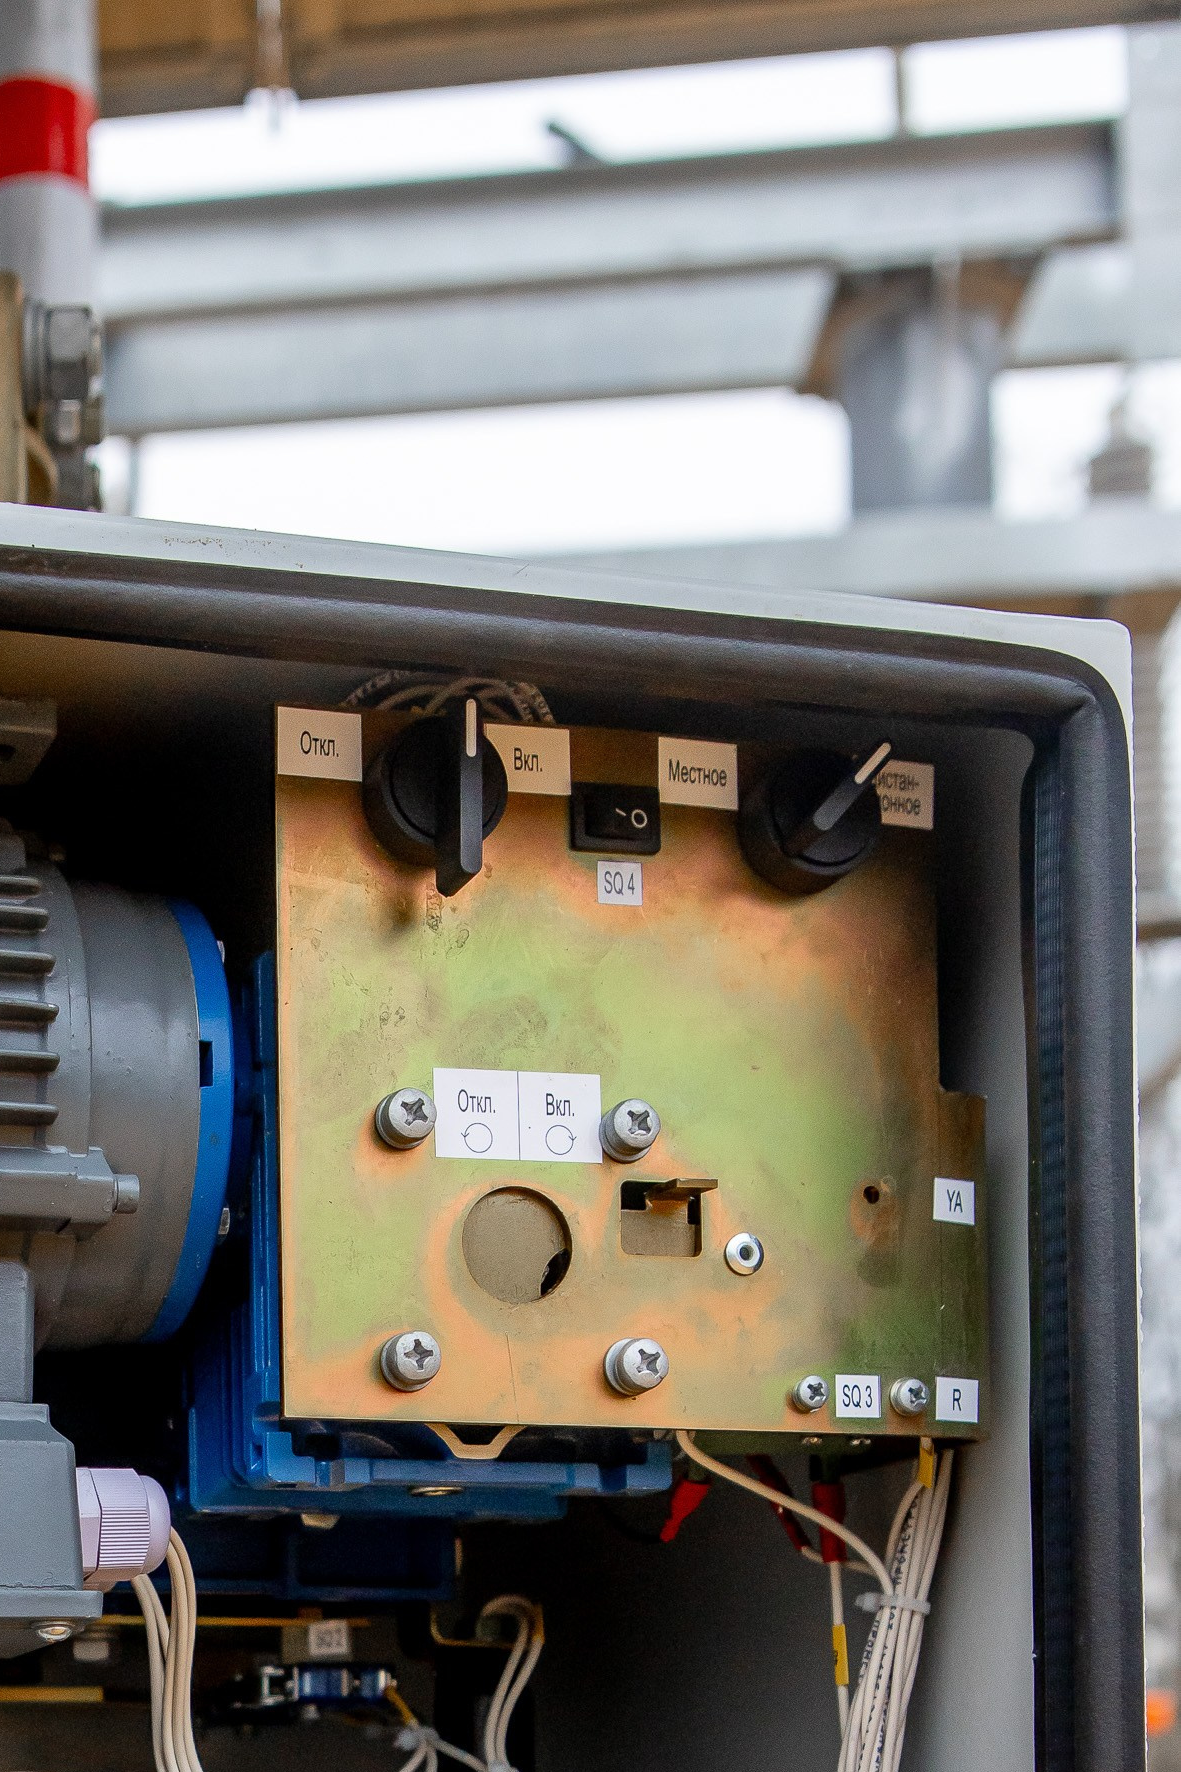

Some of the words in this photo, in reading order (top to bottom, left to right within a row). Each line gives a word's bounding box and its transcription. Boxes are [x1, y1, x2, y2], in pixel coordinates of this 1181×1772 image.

[299, 730, 339, 757] Откл.
[513, 747, 543, 773] Вкл.
[668, 757, 728, 789] Местное
[875, 772, 919, 791] истан-
[604, 872, 622, 897] SQ
[625, 872, 635, 895] 4
[458, 1090, 495, 1113] Откл.
[545, 1093, 576, 1118] Вкл.
[945, 1190, 963, 1214] YA
[842, 1384, 859, 1410] SQ
[863, 1384, 873, 1408] 3
[951, 1388, 960, 1410] R
